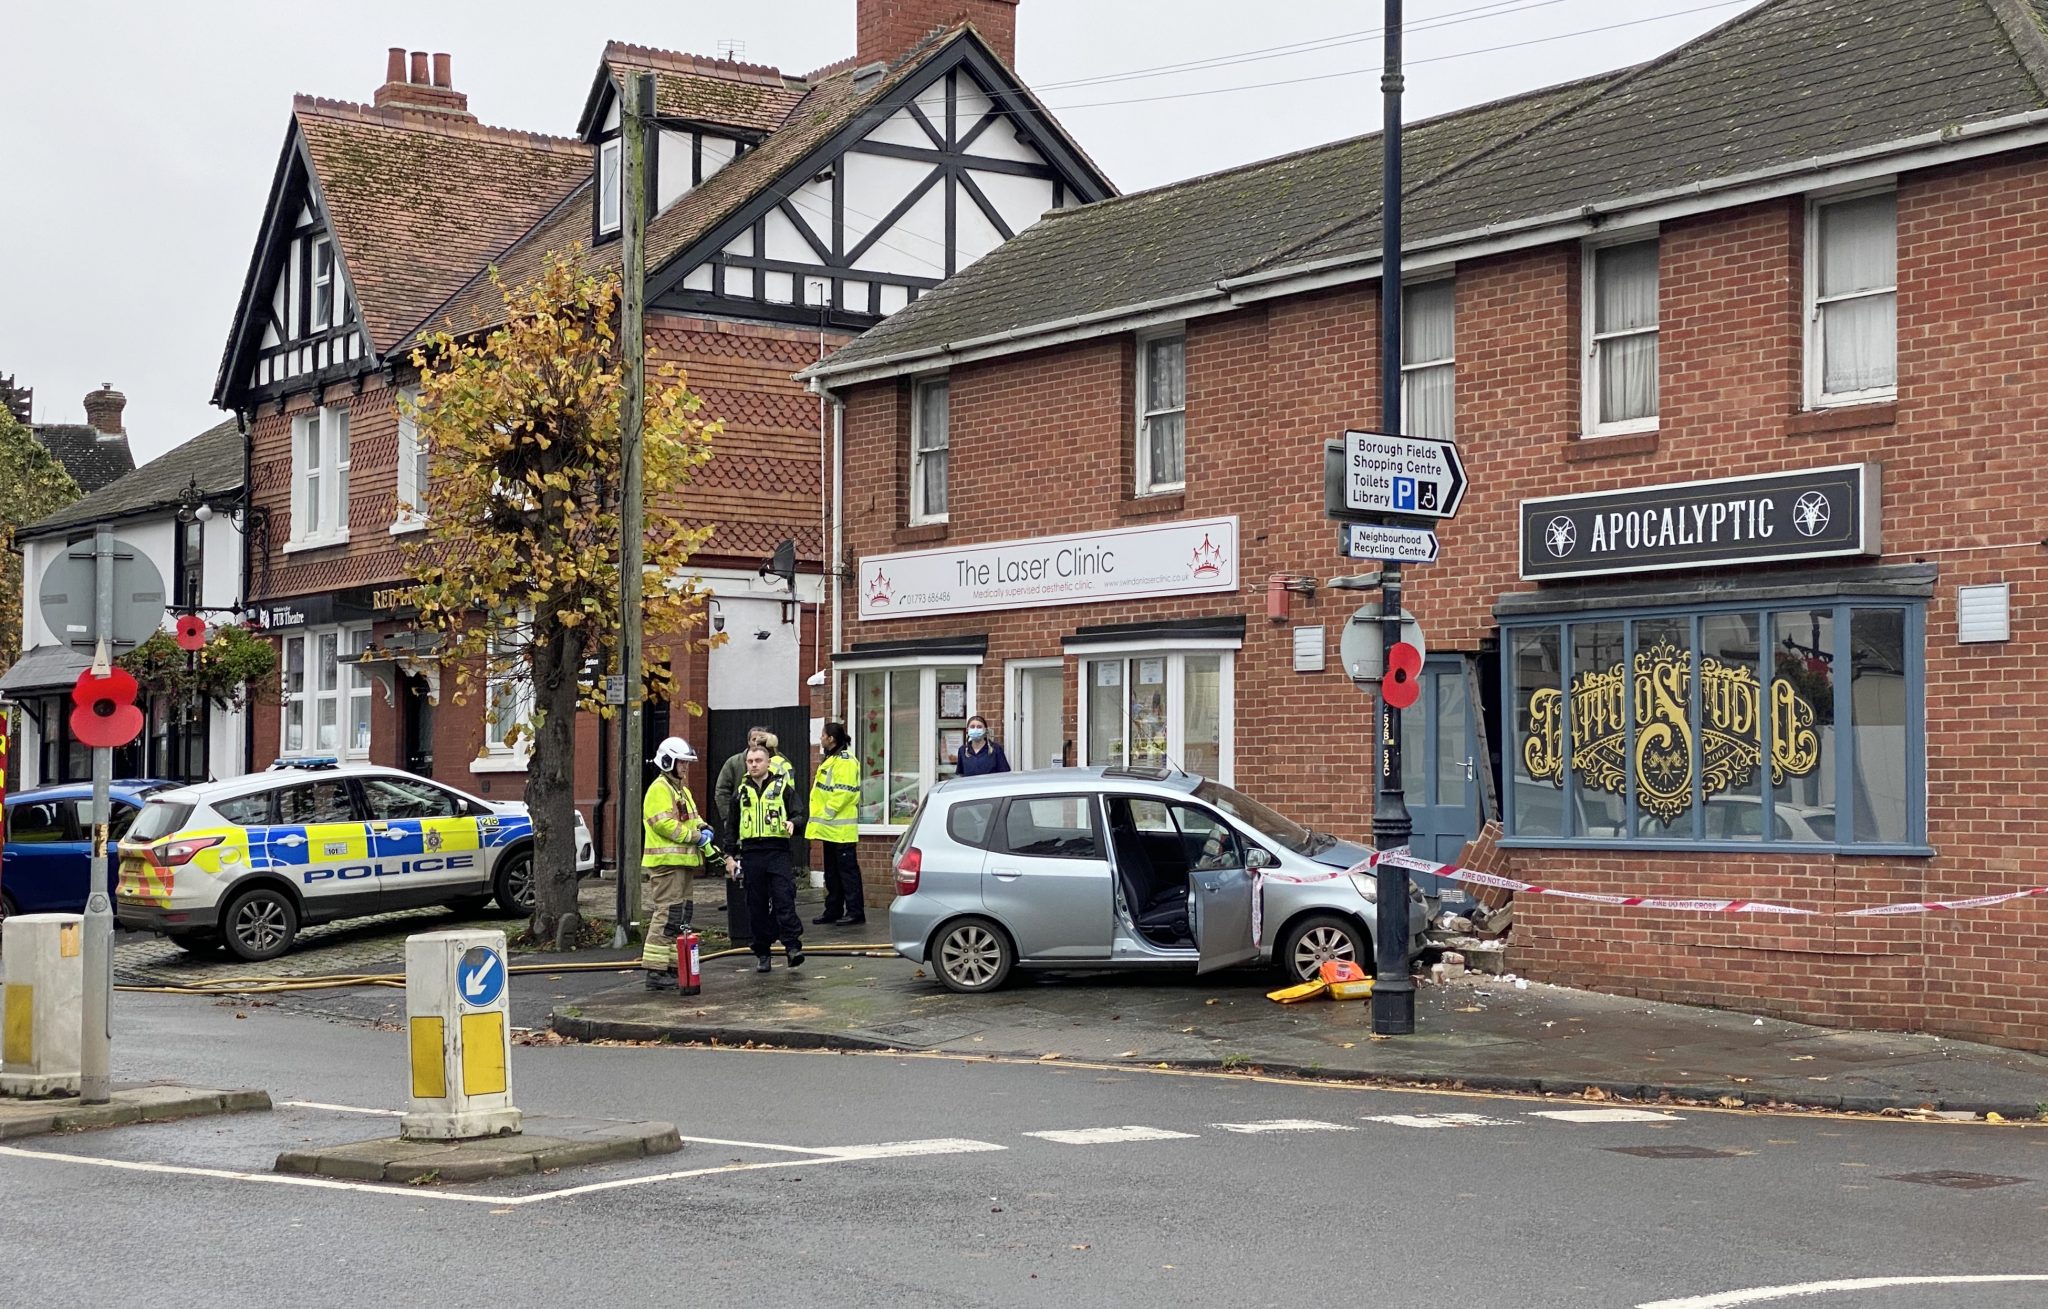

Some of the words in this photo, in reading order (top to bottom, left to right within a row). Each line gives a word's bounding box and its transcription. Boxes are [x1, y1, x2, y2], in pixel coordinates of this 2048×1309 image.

[1359, 439, 1403, 457] Borough
[1406, 444, 1437, 459] Fields
[1353, 455, 1403, 473] Shopping
[1406, 461, 1442, 475] Centre
[1354, 473, 1389, 488] Toilets
[1353, 490, 1390, 507] Library
[1398, 479, 1411, 507] P
[1591, 498, 1774, 552] APOCALYPTIC
[1359, 531, 1421, 544] Neighbourhood
[1354, 543, 1395, 556] Recycling
[1398, 545, 1426, 557] Centre
[956, 559, 990, 587] The
[997, 556, 1050, 583] Laser
[1056, 545, 1115, 577] Clinic
[973, 586, 1004, 600] Medically
[1005, 583, 1041, 599] supervised
[1041, 579, 1073, 594] aesthetic
[373, 589, 396, 610] RED
[906, 593, 926, 605] 01793
[273, 612, 284, 627] PUB
[285, 611, 304, 625] Theatre
[1706, 745, 1730, 764] 2007
[482, 817, 498, 826] 218
[303, 855, 474, 884] POLICE
[1410, 860, 1431, 871] CROSS
[1461, 871, 1475, 880] FIRE
[1476, 874, 1486, 883] DO
[1487, 876, 1500, 886] NOT
[1501, 879, 1523, 889] CROSS
[1694, 902, 1717, 910] CROSS
